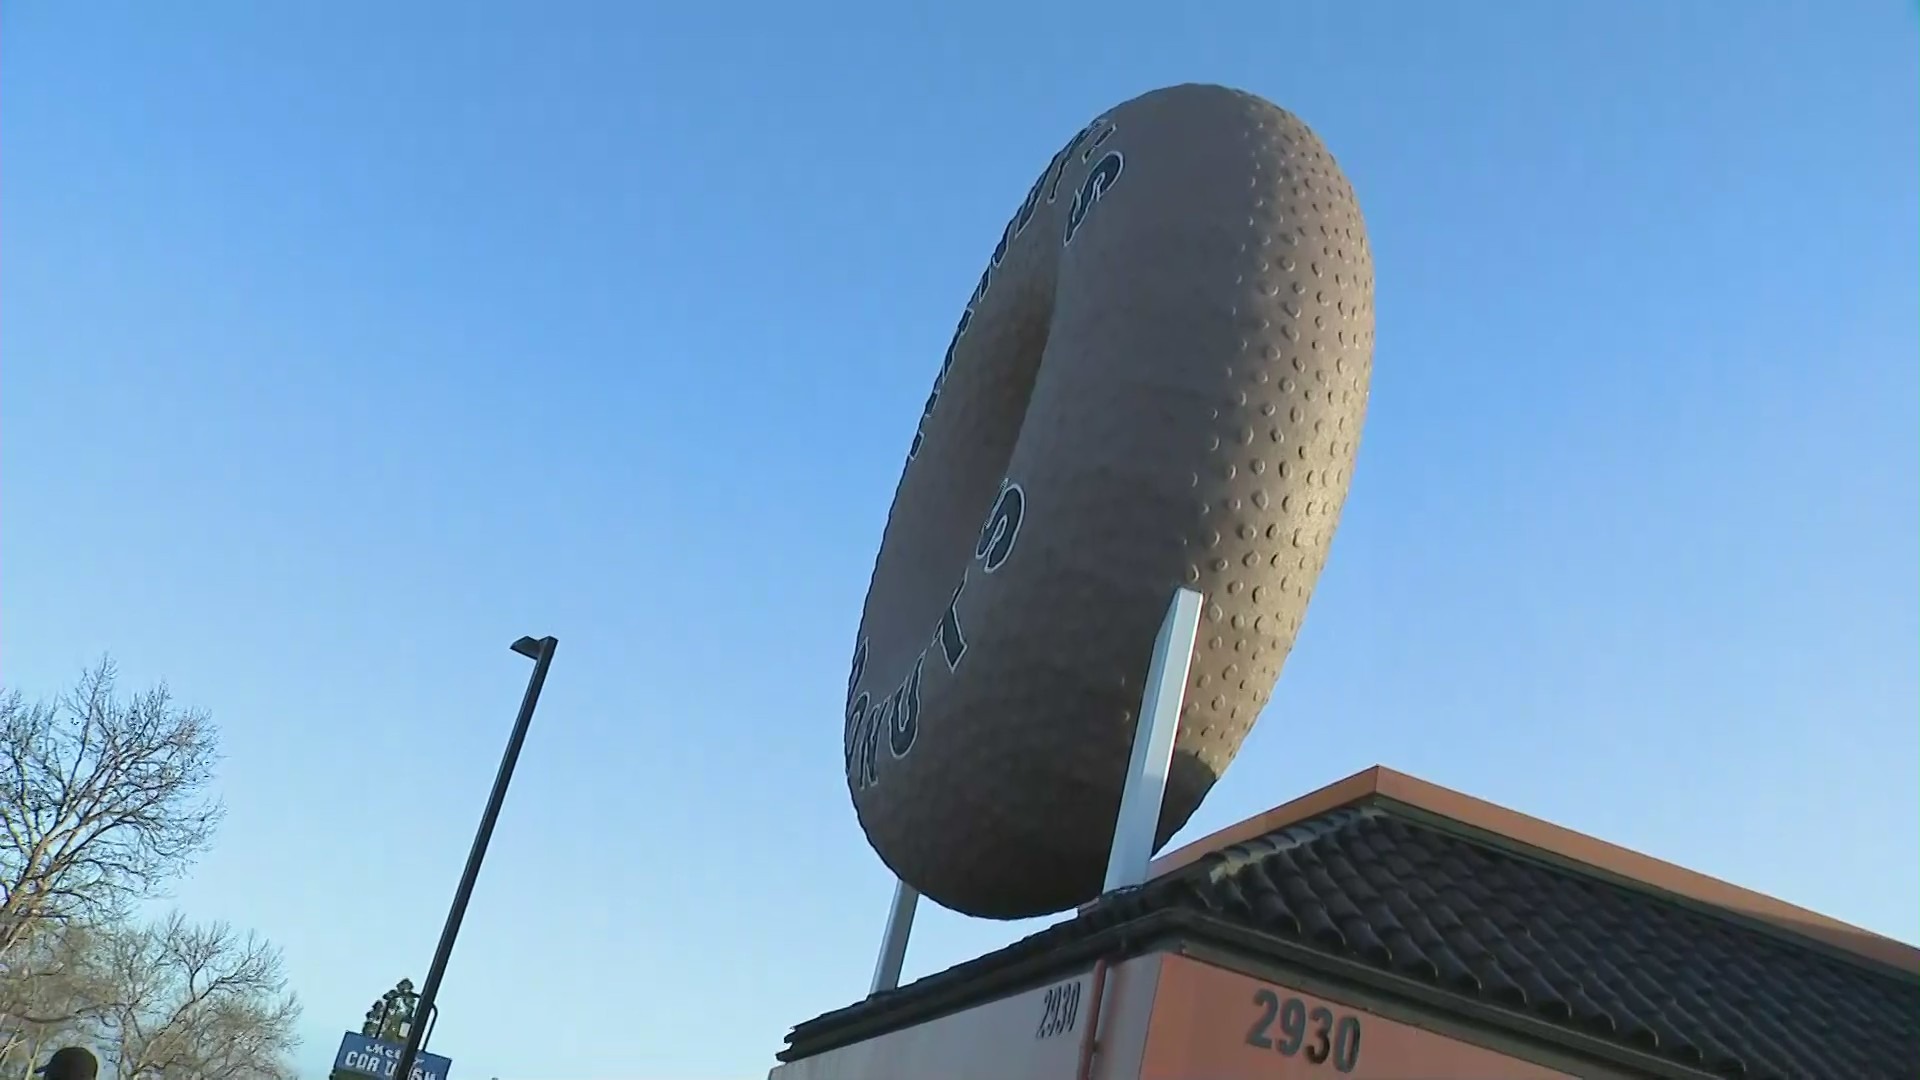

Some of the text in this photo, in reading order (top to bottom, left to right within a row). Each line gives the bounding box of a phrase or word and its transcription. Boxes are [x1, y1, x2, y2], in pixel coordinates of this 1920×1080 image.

[1035, 981, 1081, 1039] 2930
[1245, 988, 1361, 1074] 2930
[385, 1059, 436, 1080] WSH
